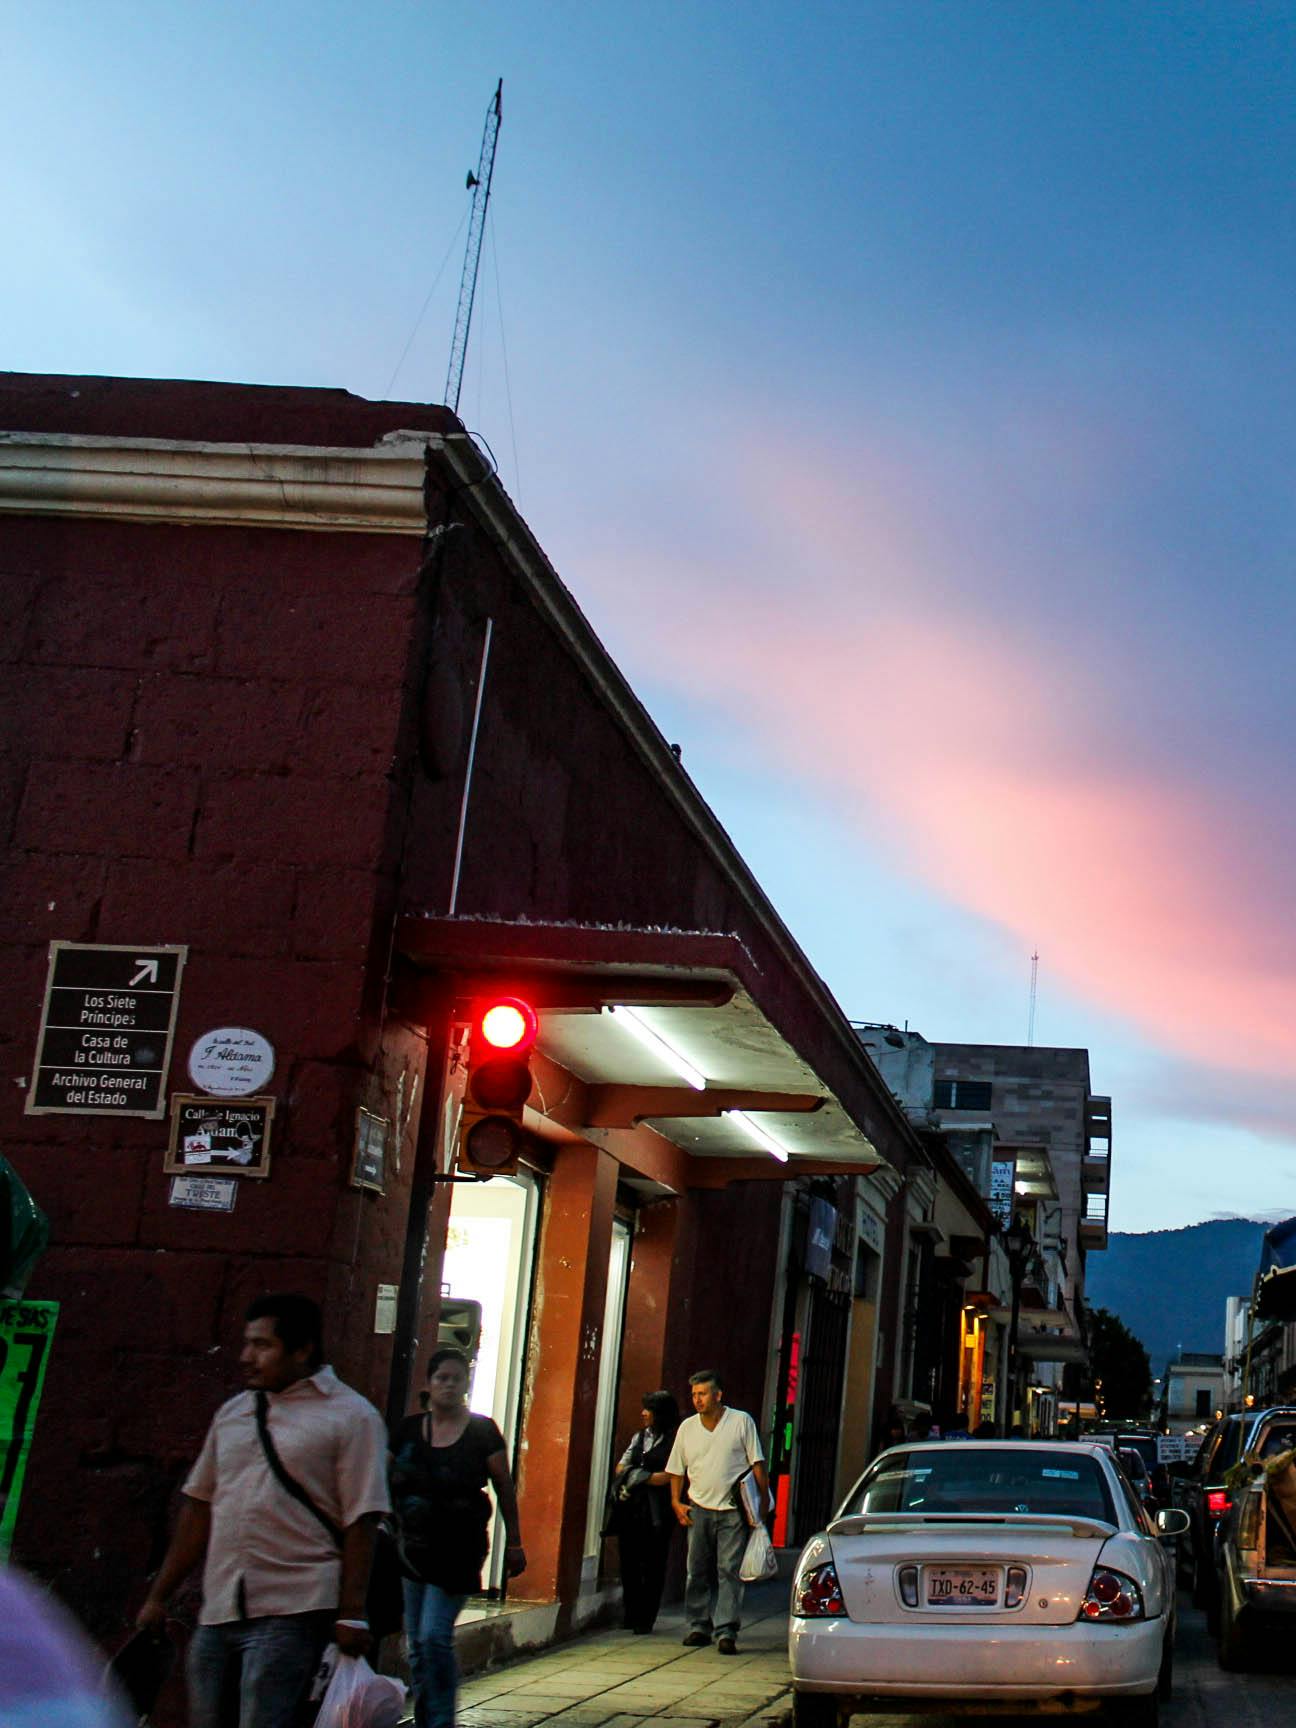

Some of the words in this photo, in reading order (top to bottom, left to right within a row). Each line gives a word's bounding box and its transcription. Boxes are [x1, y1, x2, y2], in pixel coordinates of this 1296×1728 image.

[84, 994, 104, 1008] Los
[107, 995, 137, 1009] Siete
[81, 1034, 110, 1048] Casa
[113, 1035, 128, 1049] de
[74, 1050, 86, 1063] la
[88, 1051, 131, 1065] Cultura
[52, 1072, 97, 1088] Archivo
[99, 1074, 147, 1090] General
[66, 1090, 86, 1104] del
[88, 1091, 127, 1105] Estado
[184, 1108, 209, 1119] Call
[226, 1110, 260, 1123] Ignacio
[931, 1579, 996, 1596] TXD-62-45
